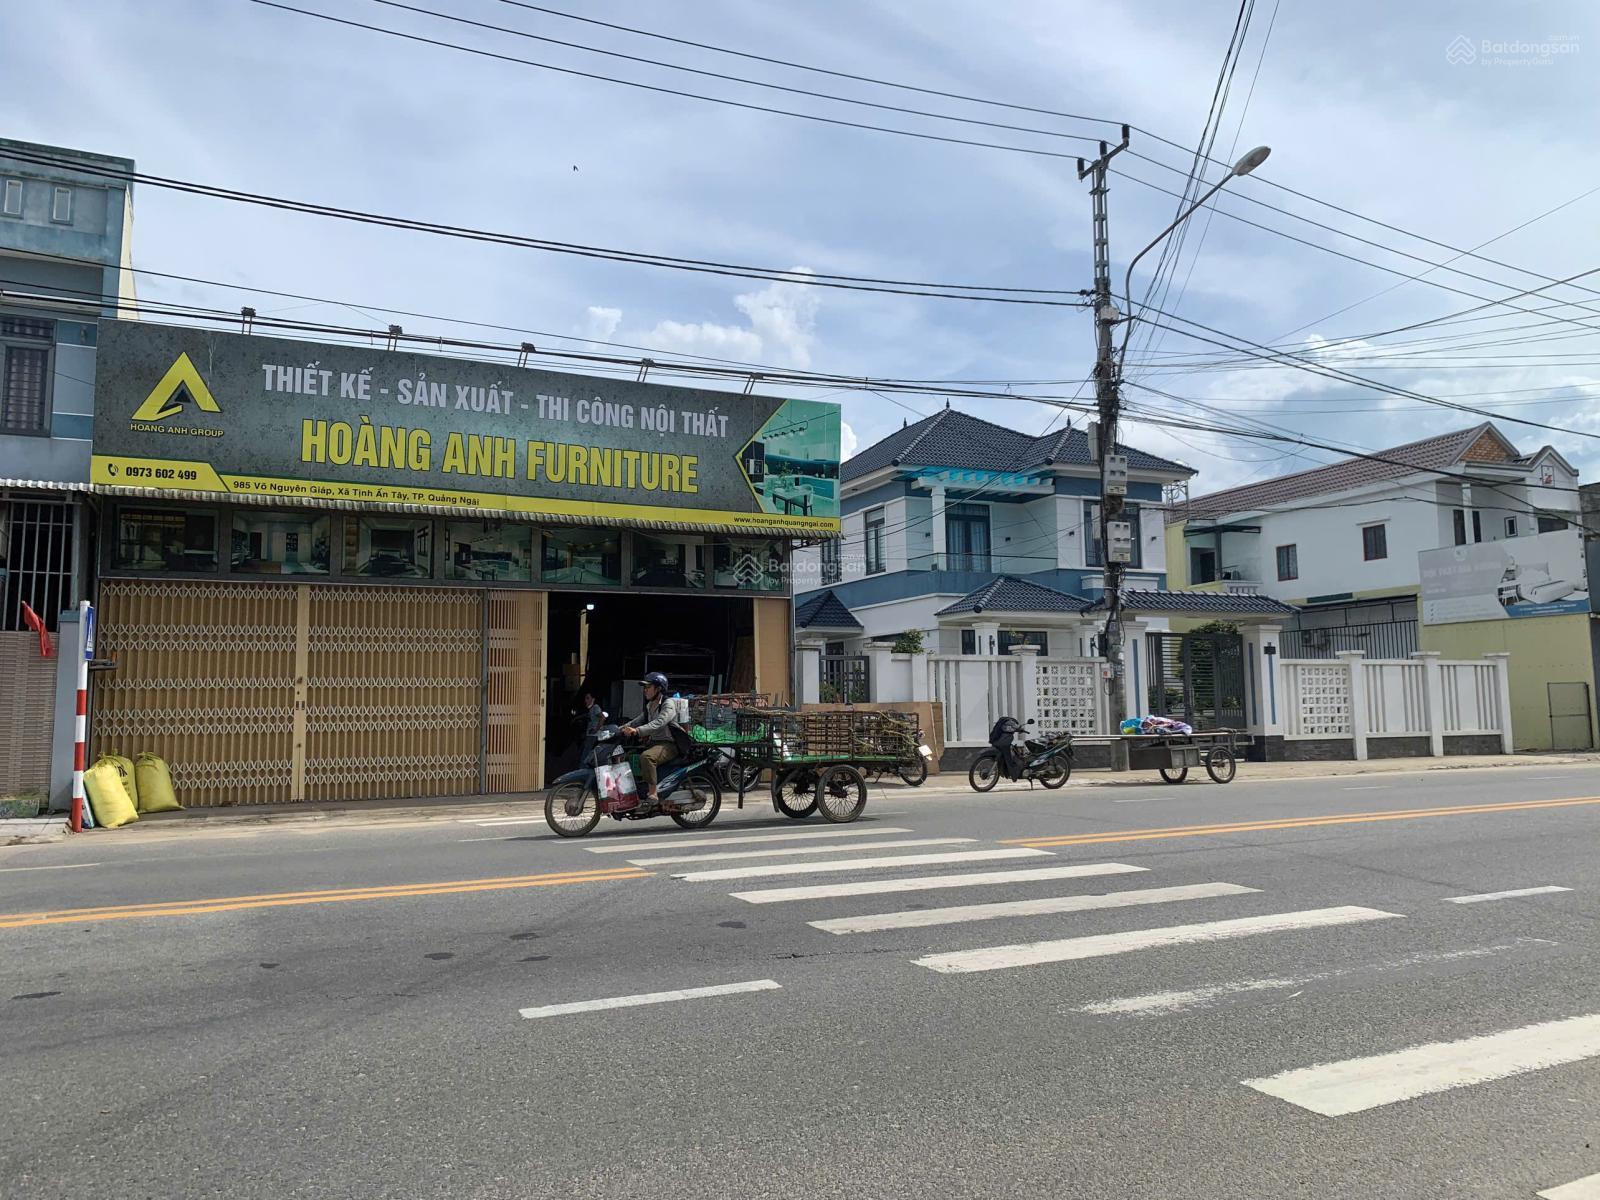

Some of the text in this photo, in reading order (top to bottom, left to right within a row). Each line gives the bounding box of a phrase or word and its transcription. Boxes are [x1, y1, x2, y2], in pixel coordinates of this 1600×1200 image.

[262, 361, 333, 397] THIẾT
[340, 366, 374, 401] KẾ
[397, 372, 447, 408] SẢN
[456, 380, 514, 415] XUẤT
[536, 394, 569, 422] THI
[576, 397, 634, 429] CÔNG
[640, 403, 675, 438] NỘI
[681, 406, 729, 438] THẤT
[130, 424, 224, 438] HOANG ANH GROUP
[301, 415, 699, 494] HOÀNG ANH FURNITURE
[126, 466, 197, 481] 0973 602 499
[233, 481, 251, 490] 985
[254, 481, 267, 491] Võ
[270, 483, 307, 495] Nguyên
[310, 485, 335, 496] Giáp,
[337, 487, 350, 496] Xã
[352, 487, 373, 498] Tịnh
[375, 487, 389, 498] Ấn
[428, 493, 457, 504] Quảng
[733, 517, 834, 528] www.hoanganhquangngai.com
